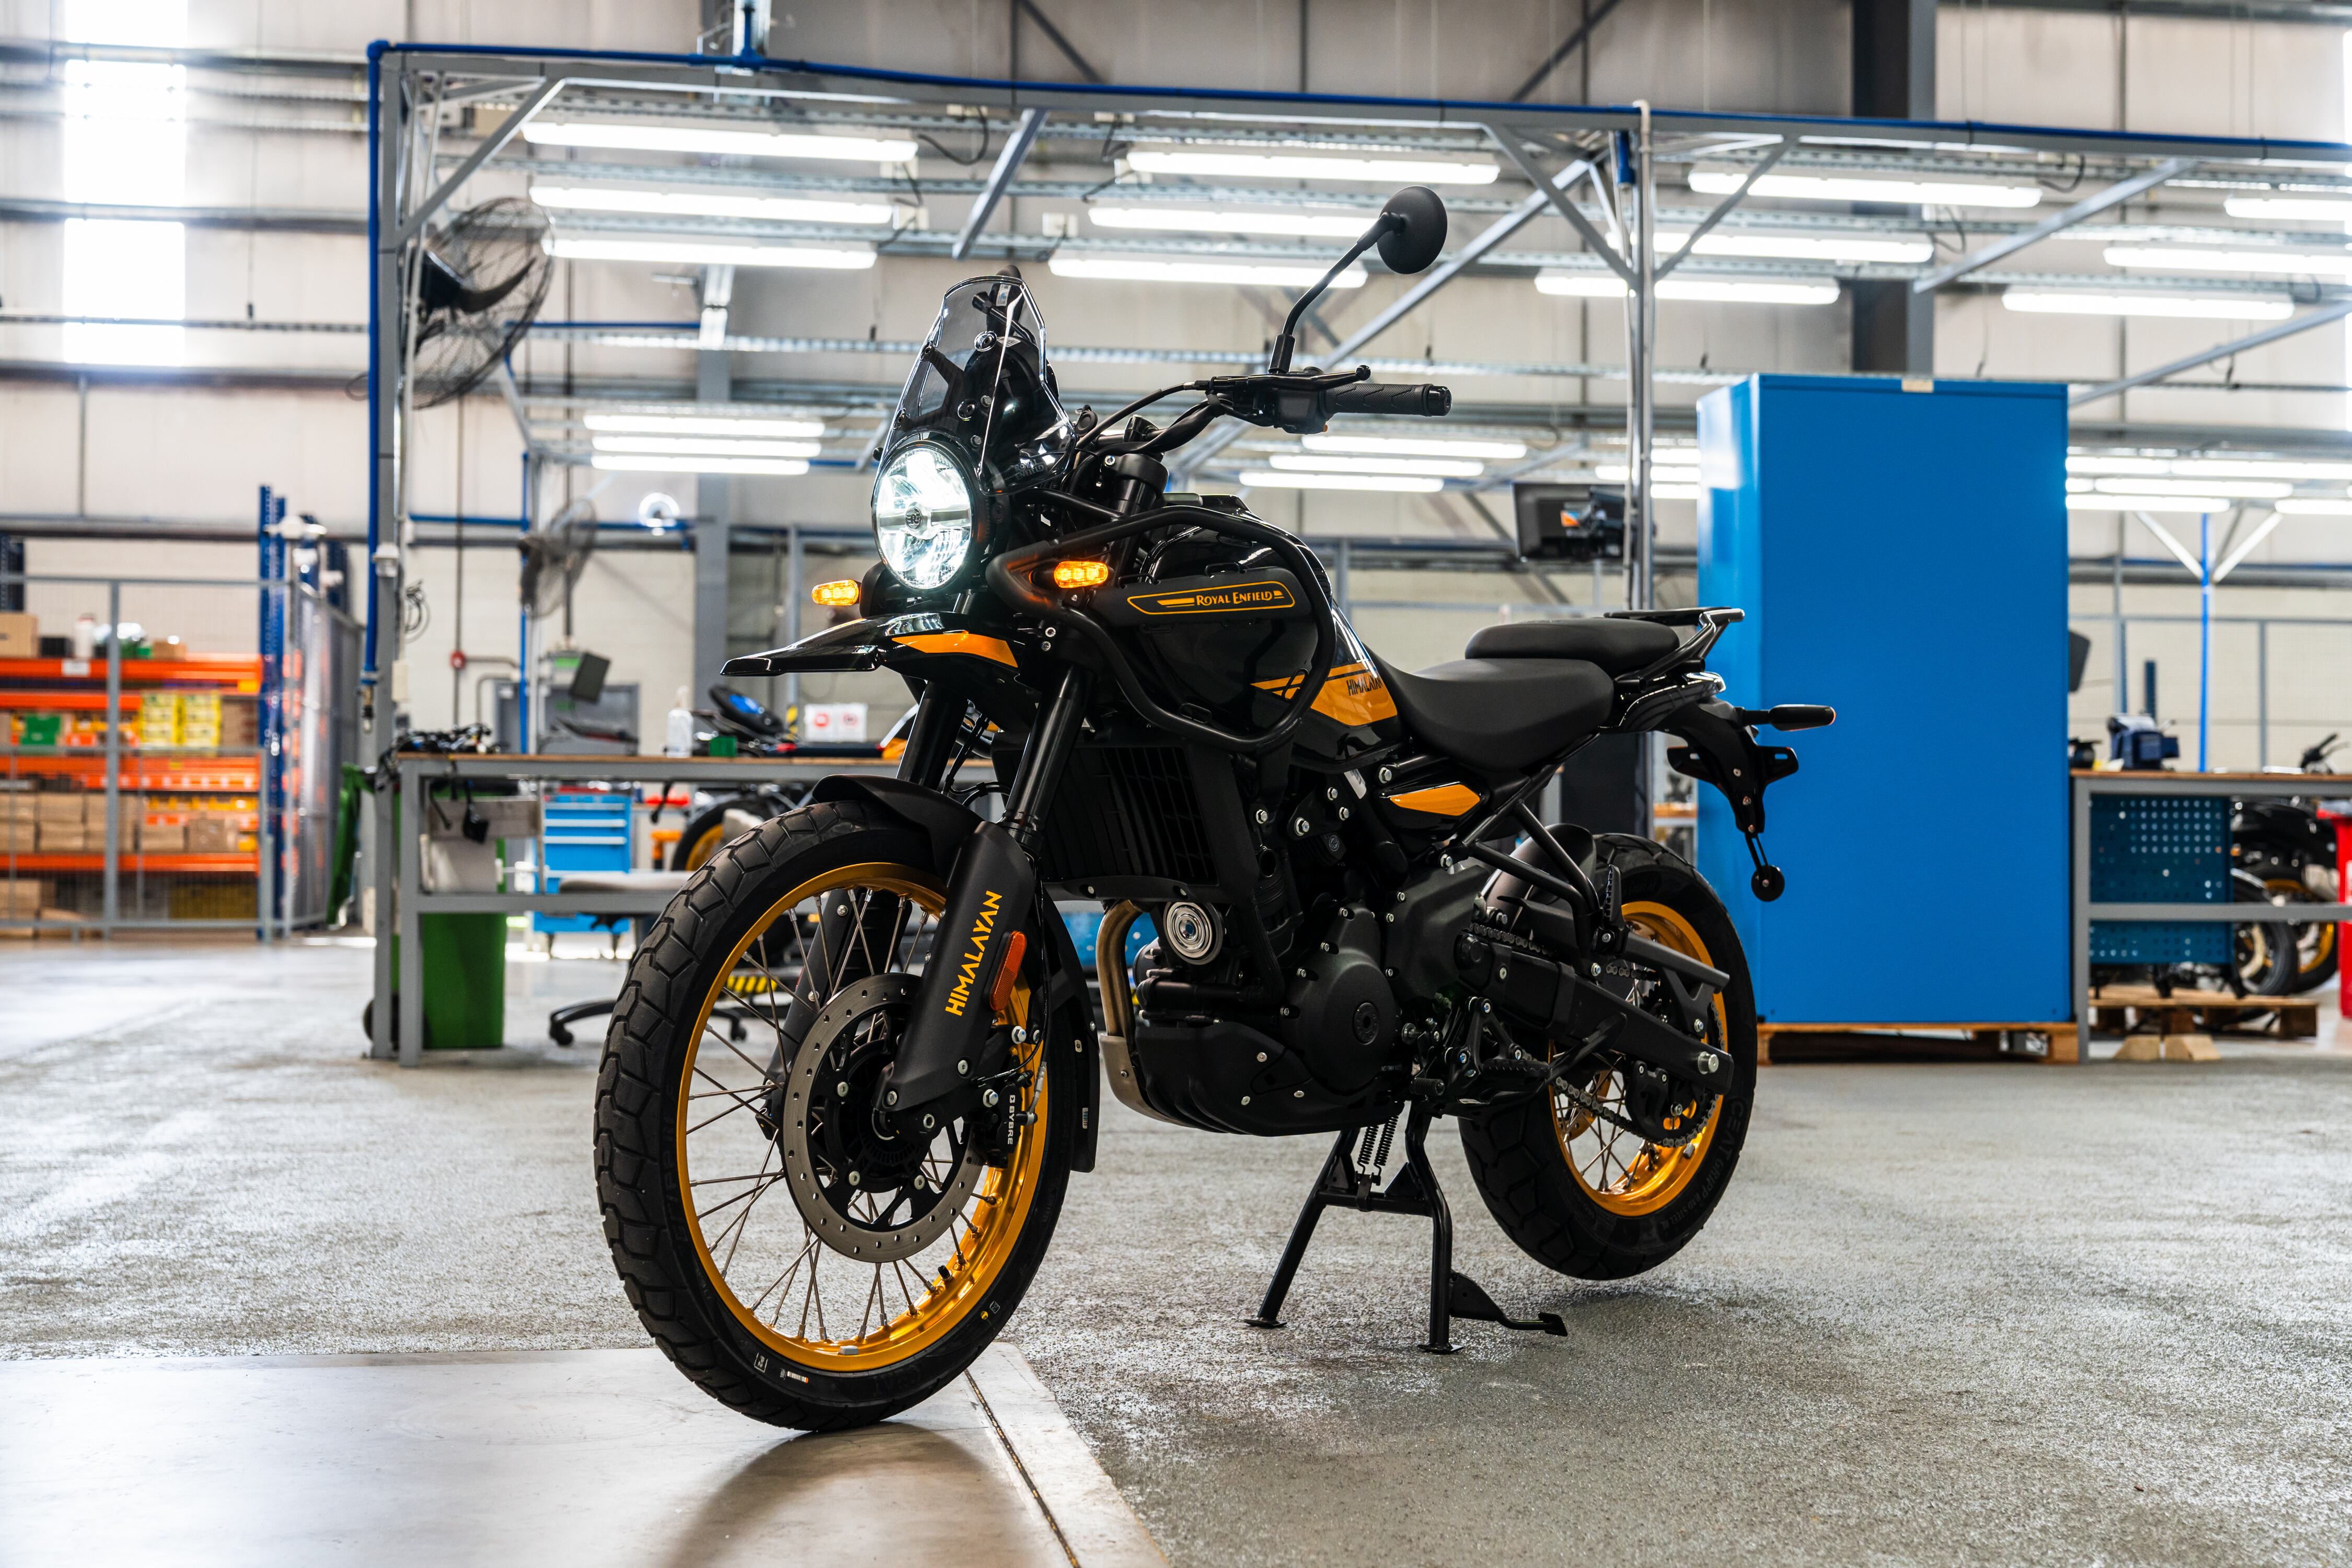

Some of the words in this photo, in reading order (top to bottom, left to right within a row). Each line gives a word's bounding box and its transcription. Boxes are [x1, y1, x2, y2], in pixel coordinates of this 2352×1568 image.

[1196, 595, 1231, 606] ROYAL
[1232, 591, 1273, 604] ENFIELD
[945, 890, 1002, 1016] HIMALAYAN
[1719, 1099, 1744, 1160] CEAT
[1701, 1157, 1724, 1200] GRIPP
